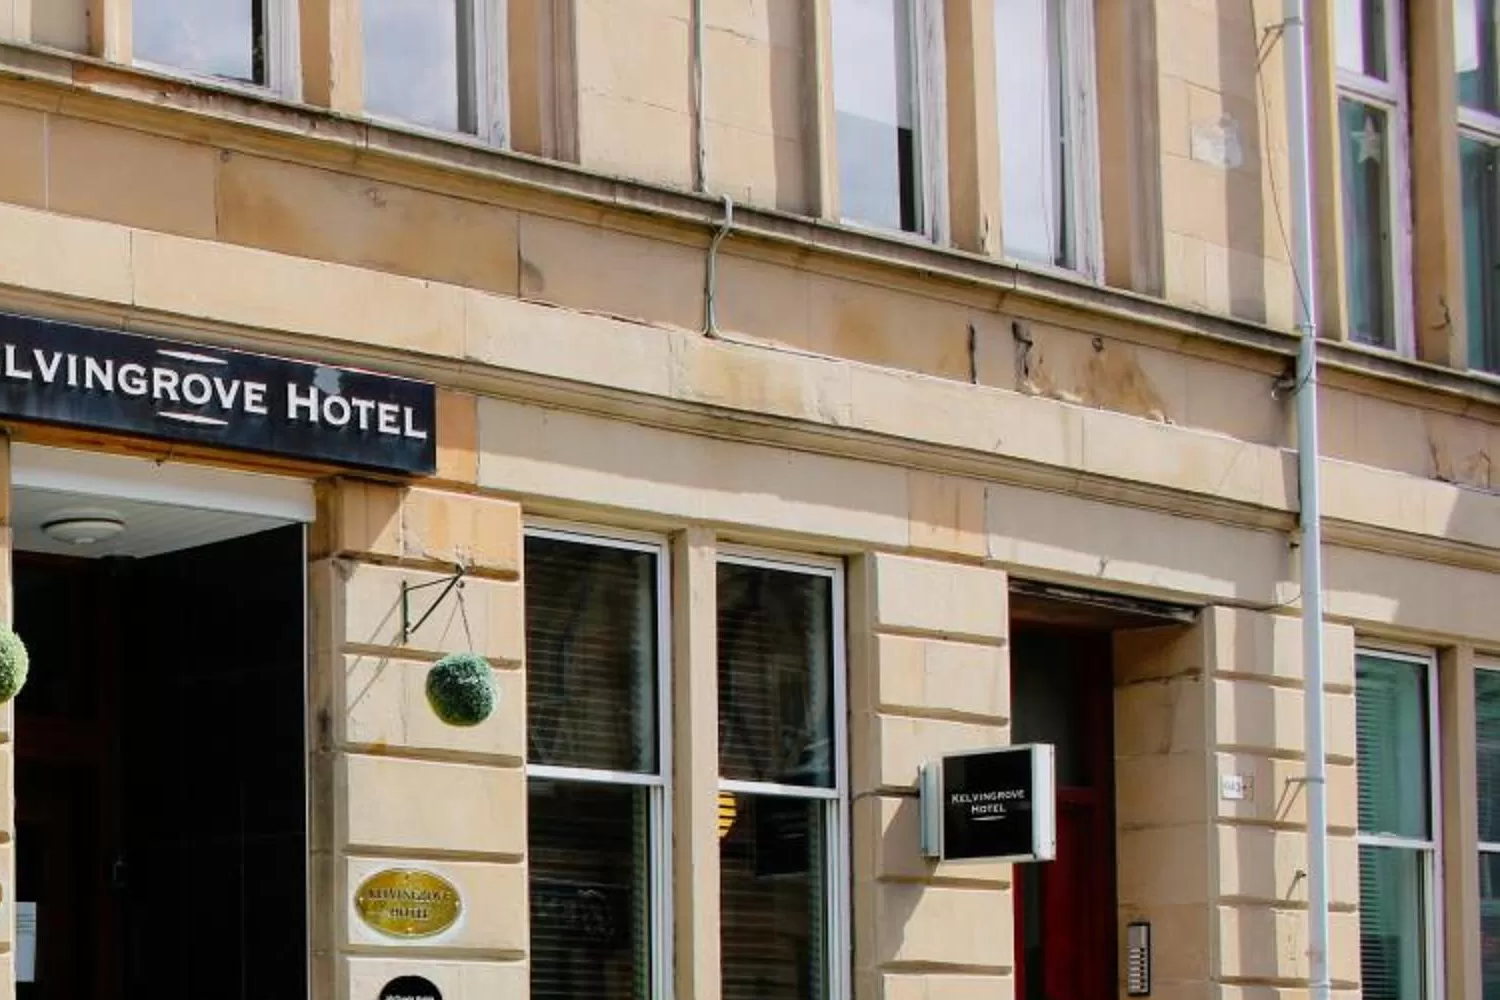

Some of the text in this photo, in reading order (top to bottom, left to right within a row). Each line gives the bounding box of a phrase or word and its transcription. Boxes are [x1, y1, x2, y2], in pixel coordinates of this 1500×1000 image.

[287, 382, 428, 439] HOTEL
[951, 789, 1025, 803] KELVINGROVE
[971, 803, 1006, 815] HOTEL
